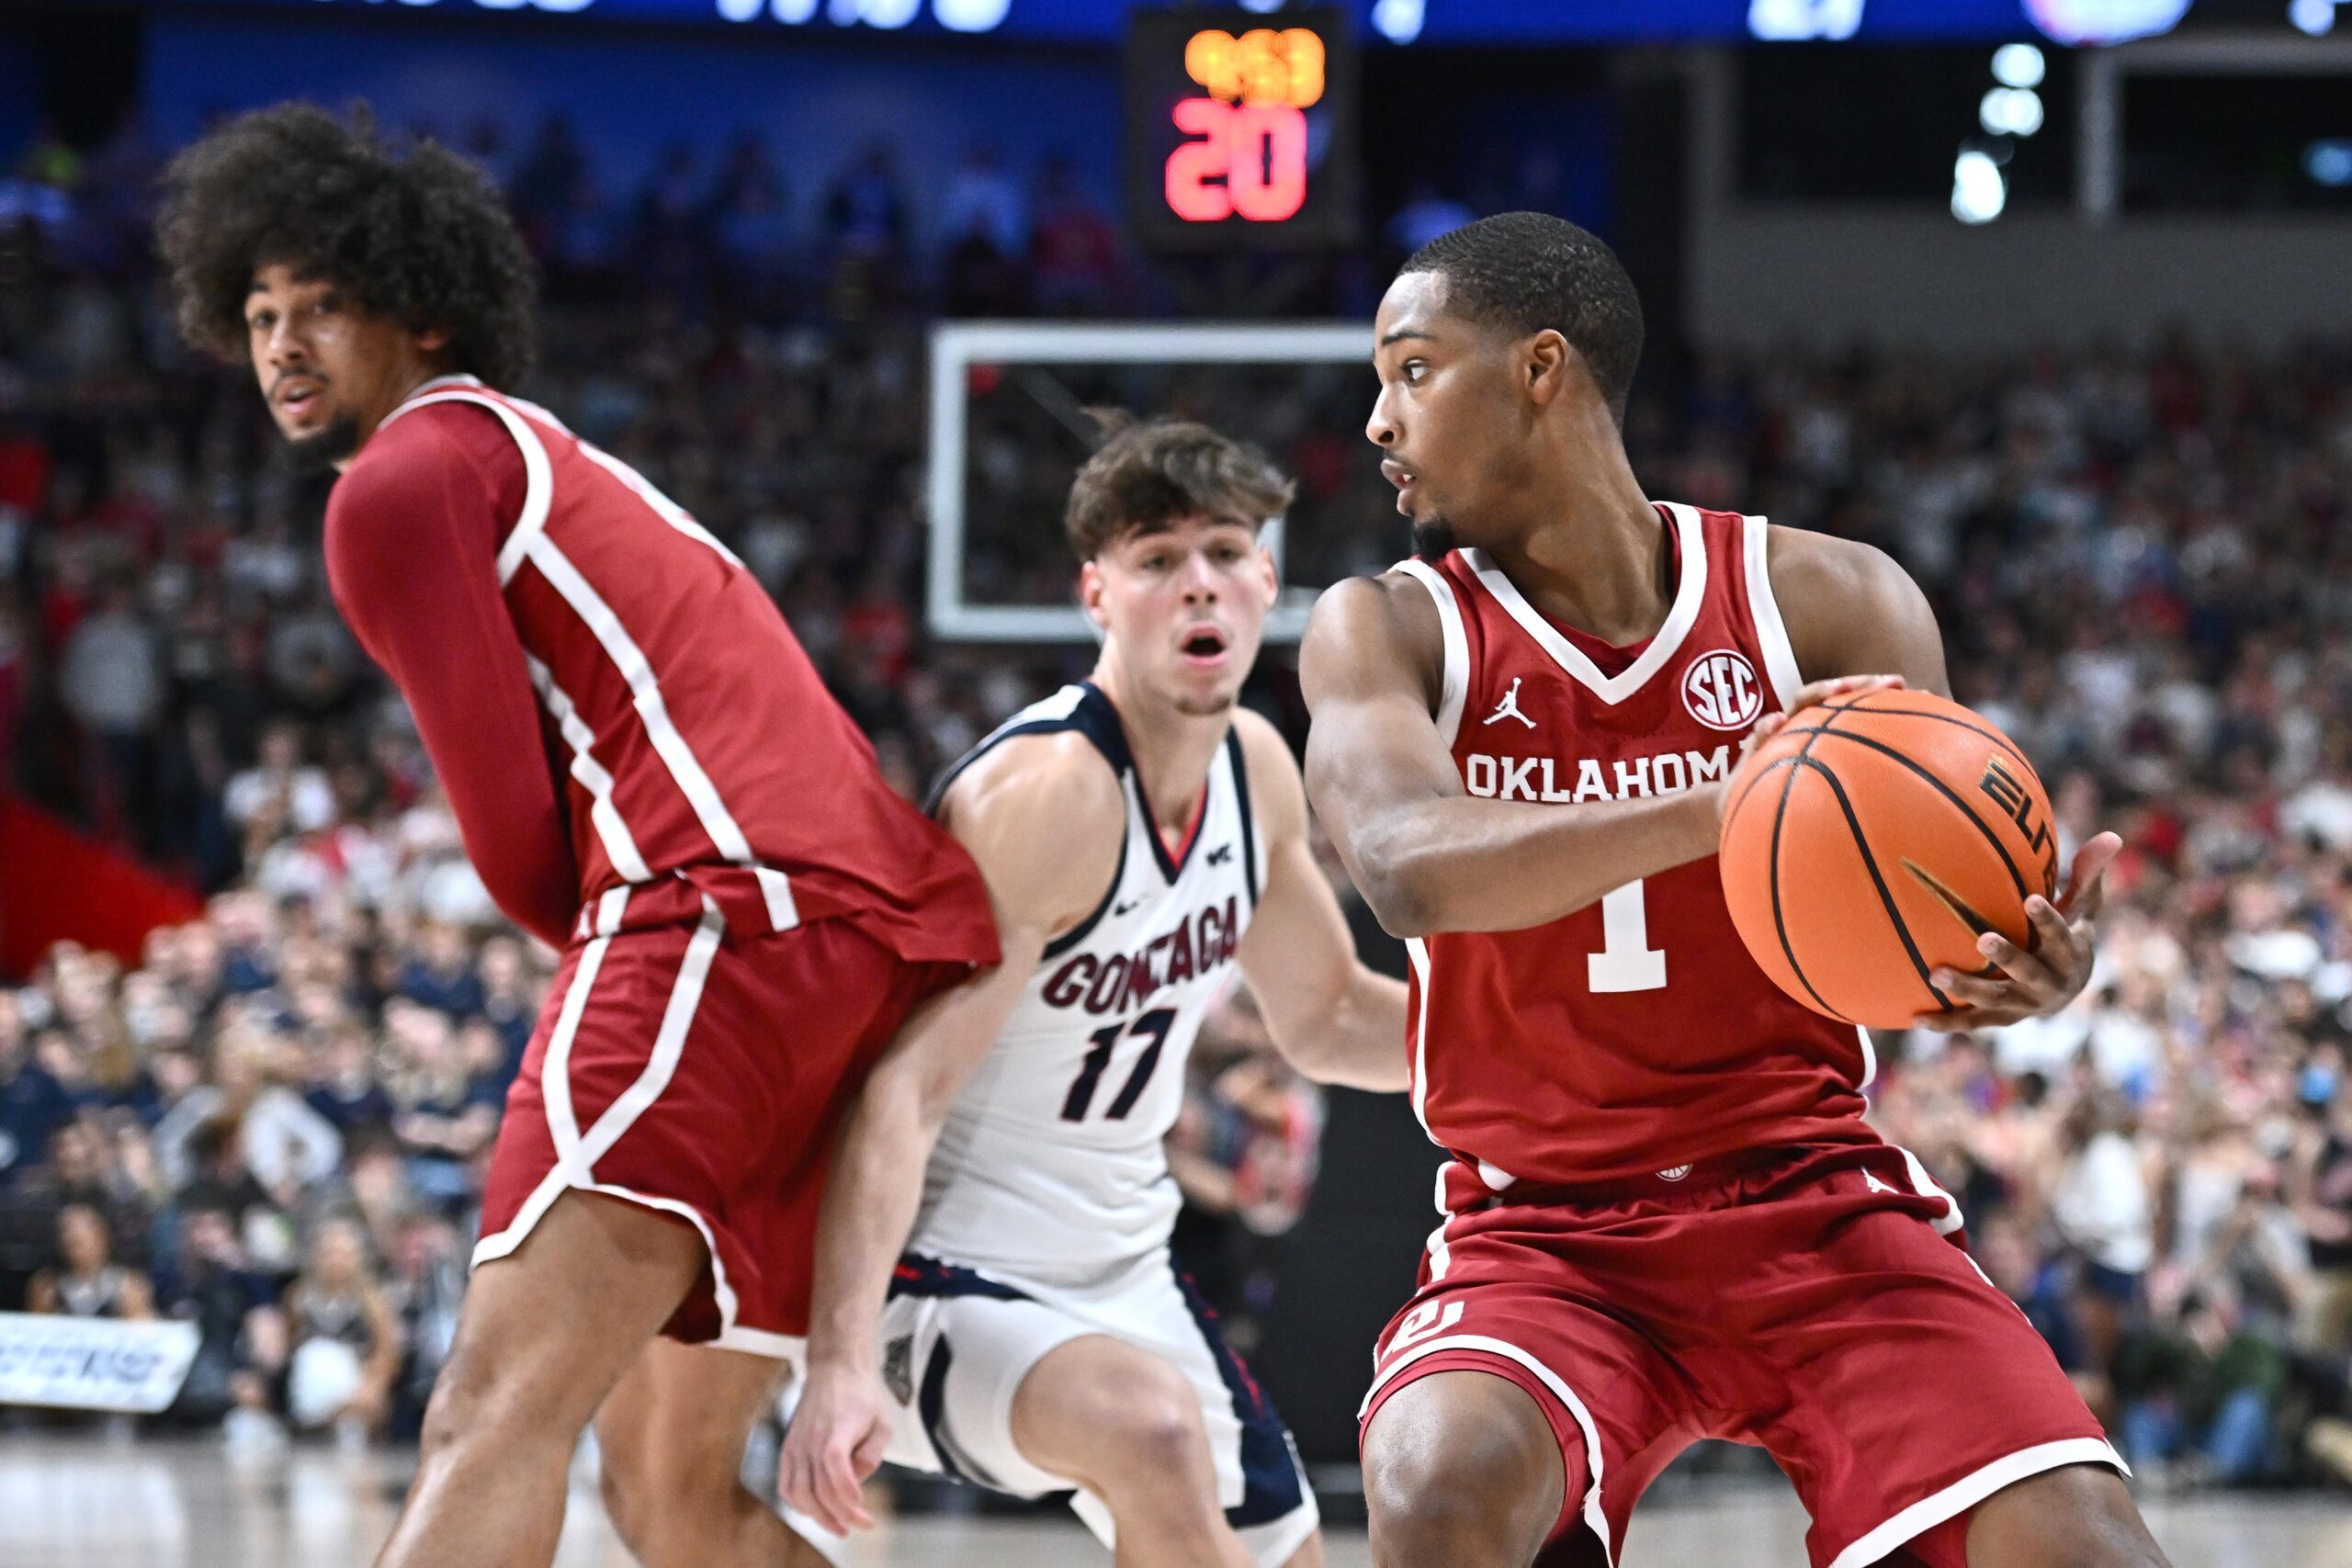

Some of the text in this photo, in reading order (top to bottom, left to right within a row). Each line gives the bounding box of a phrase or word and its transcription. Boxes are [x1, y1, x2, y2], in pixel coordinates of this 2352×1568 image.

[1165, 97, 1306, 220] 20
[1687, 656, 1758, 727] SEC
[1467, 739, 1747, 803] OKLAHOM
[1587, 878, 1668, 993] 1
[1059, 1006, 1178, 1122] 17
